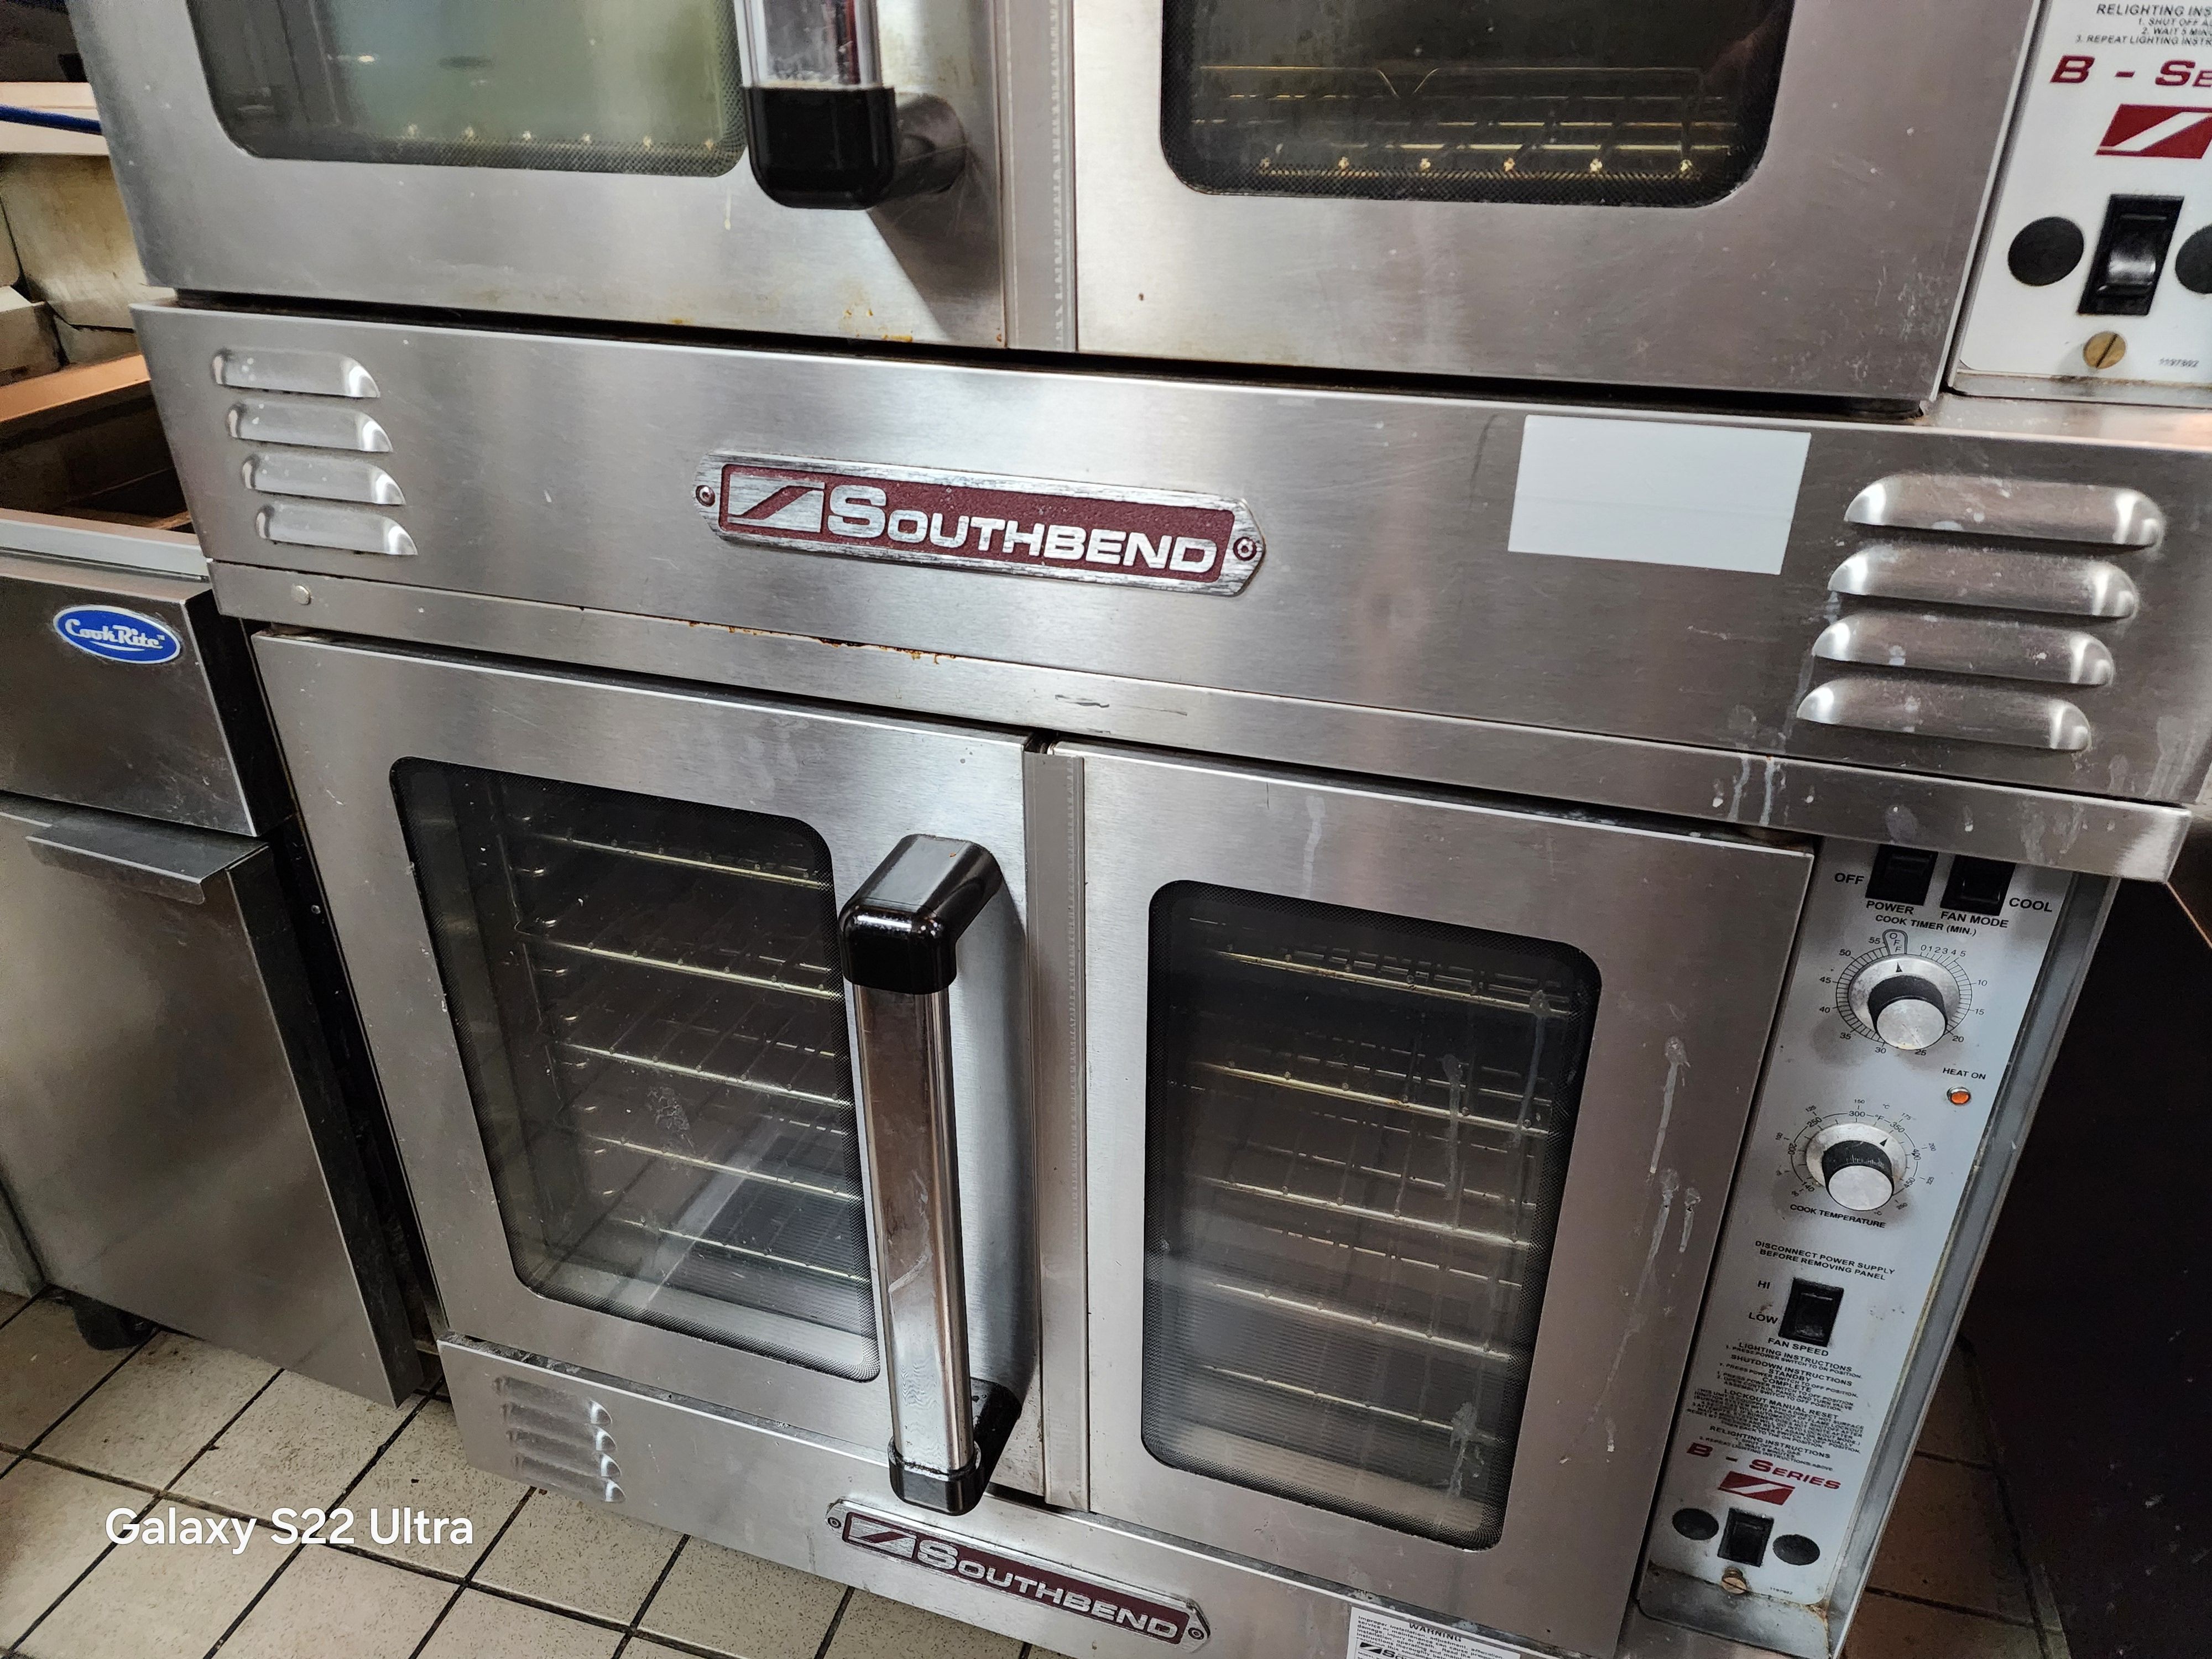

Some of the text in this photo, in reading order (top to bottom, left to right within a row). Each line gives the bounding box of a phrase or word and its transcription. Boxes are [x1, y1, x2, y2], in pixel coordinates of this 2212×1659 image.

[2096, 3, 2184, 17] RELIGHTING
[2148, 17, 2177, 26] SHUT
[2179, 18, 2198, 27] OFF
[2086, 35, 2128, 44] REPEAT
[2130, 35, 2179, 45] LIGHTING
[2049, 55, 2095, 84] B
[1834, 873, 1864, 885] OFF
[1866, 900, 1915, 915] POWER
[2008, 897, 2053, 912] COOL
[1875, 915, 1977, 937] COOK TIMER (MIN.)
[1940, 911, 2009, 928] FAN MODE
[1869, 936, 1881, 945] 55
[1839, 948, 1851, 957] 50
[1819, 976, 1832, 984] 45
[1840, 1032, 1852, 1040] 35
[1952, 1035, 1964, 1044] 20
[1943, 1067, 1986, 1080] HEAT ON
[1806, 1117, 1822, 1128] 250
[1890, 1121, 1905, 1133] 350
[1787, 1142, 1797, 1155] 200
[1912, 1149, 1921, 1161] 400
[1903, 1177, 1916, 1188] 450
[1790, 1204, 1886, 1228] COOK TEMPERATURE
[1755, 1240, 1896, 1275] DISCONNECT POWER SUPPLY
[1759, 1249, 1886, 1280] BEFORE REMOVING PANEL
[1757, 1280, 1771, 1290] HI
[1748, 1312, 1778, 1324] LOW
[1768, 1337, 1829, 1357] FAN SPEED
[1731, 1346, 1754, 1354] PRESS
[1755, 1352, 1780, 1360] POWER
[1780, 1357, 1807, 1366] SWITCH
[1738, 1342, 1852, 1373] LIGHTING INSTRUCTIONS
[1730, 1354, 1852, 1386] SHUTDOWN INSTRUCTIONS
[1749, 1369, 1772, 1378] POWER
[1773, 1375, 1799, 1384] SWITCH
[1768, 1368, 1811, 1383] STANDBY
[1761, 1376, 1812, 1392] COMPLETE
[1771, 1384, 1797, 1393] SWITCH
[1724, 1388, 1766, 1402] LOCKOUT
[1768, 1399, 1807, 1412] MANUAL
[1808, 1408, 1837, 1420] RESET
[1709, 1425, 1764, 1442] RELIGHTING
[1764, 1439, 1831, 1459] INSTRUCTIONS
[1686, 1442, 1713, 1457] B
[1358, 1615, 1387, 1627] Improper
[1358, 1620, 1380, 1629] service
[1391, 1629, 1433, 1643] maintenance
[1449, 1646, 1468, 1654] cause
[1386, 1632, 1405, 1641] injury
[1409, 1623, 1462, 1642] WARNING
[1355, 1632, 1394, 1646] instructions
[1395, 1643, 1430, 1655] thoroughly
[1395, 1639, 1427, 1651] operating
